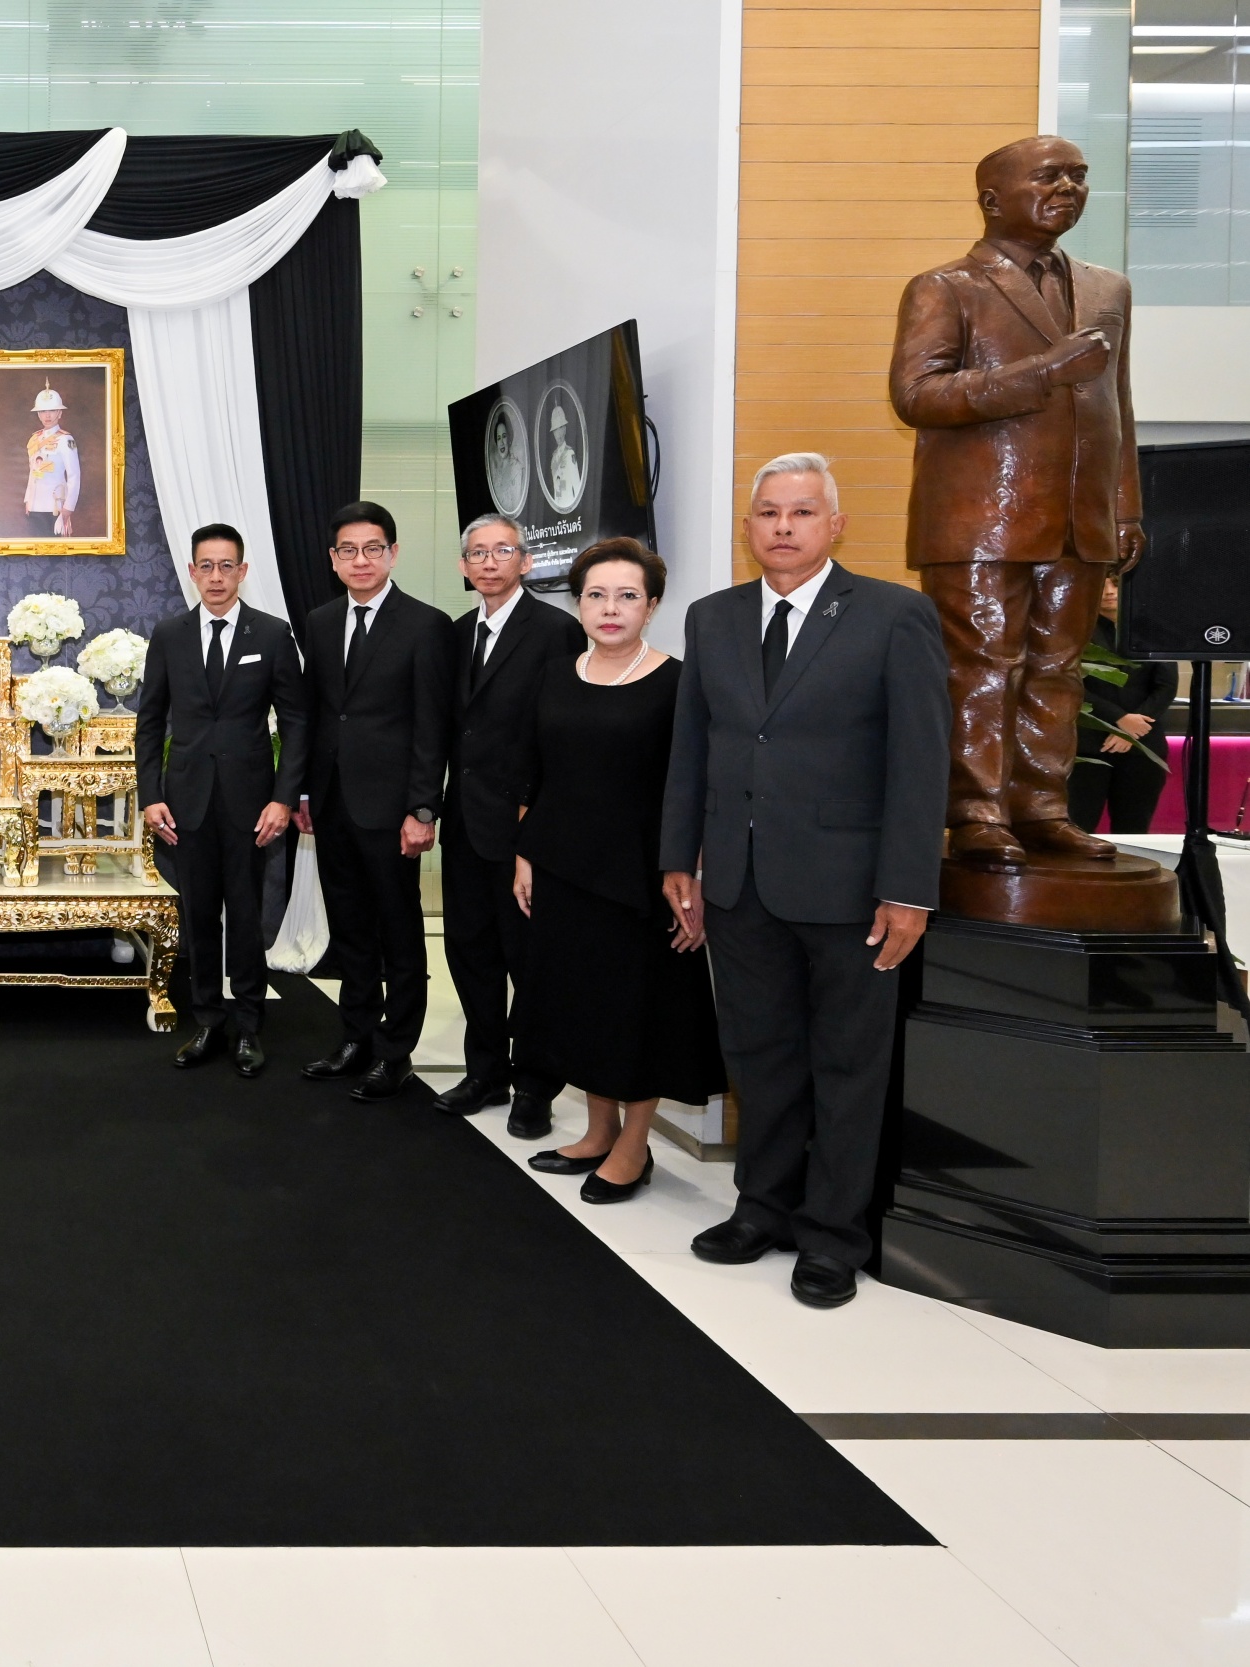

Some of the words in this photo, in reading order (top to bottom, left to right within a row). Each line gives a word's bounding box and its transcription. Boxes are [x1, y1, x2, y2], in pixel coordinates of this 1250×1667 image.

[524, 516, 582, 541] ในใจตราบนิรันดร์
